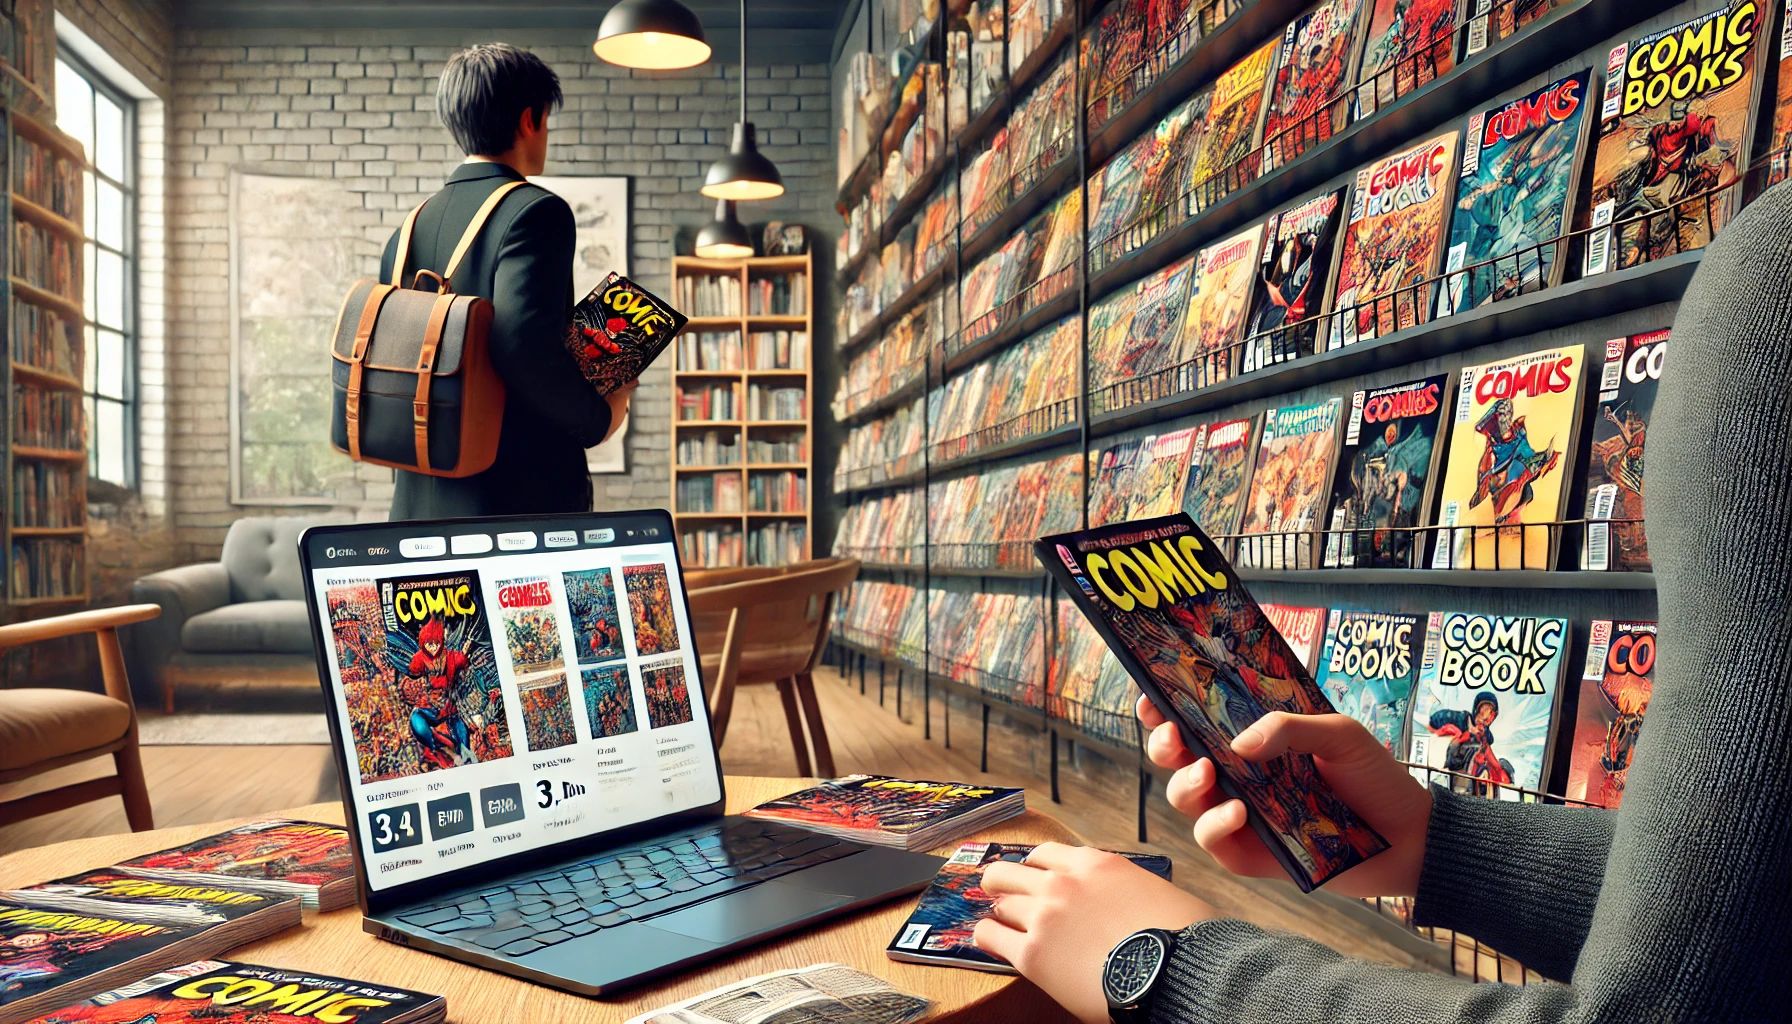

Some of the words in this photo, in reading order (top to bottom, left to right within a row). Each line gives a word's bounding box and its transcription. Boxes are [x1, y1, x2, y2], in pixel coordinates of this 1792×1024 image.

[1627, 2, 1756, 79] COMIC
[1623, 45, 1748, 116] BOOKS
[1086, 535, 1228, 612] COMIC
[1338, 618, 1413, 651] COMIC
[1442, 613, 1563, 658] COMIC
[1329, 641, 1412, 680] BOOKS
[1440, 650, 1549, 695] BOOK
[171, 975, 392, 1024] COMIC
